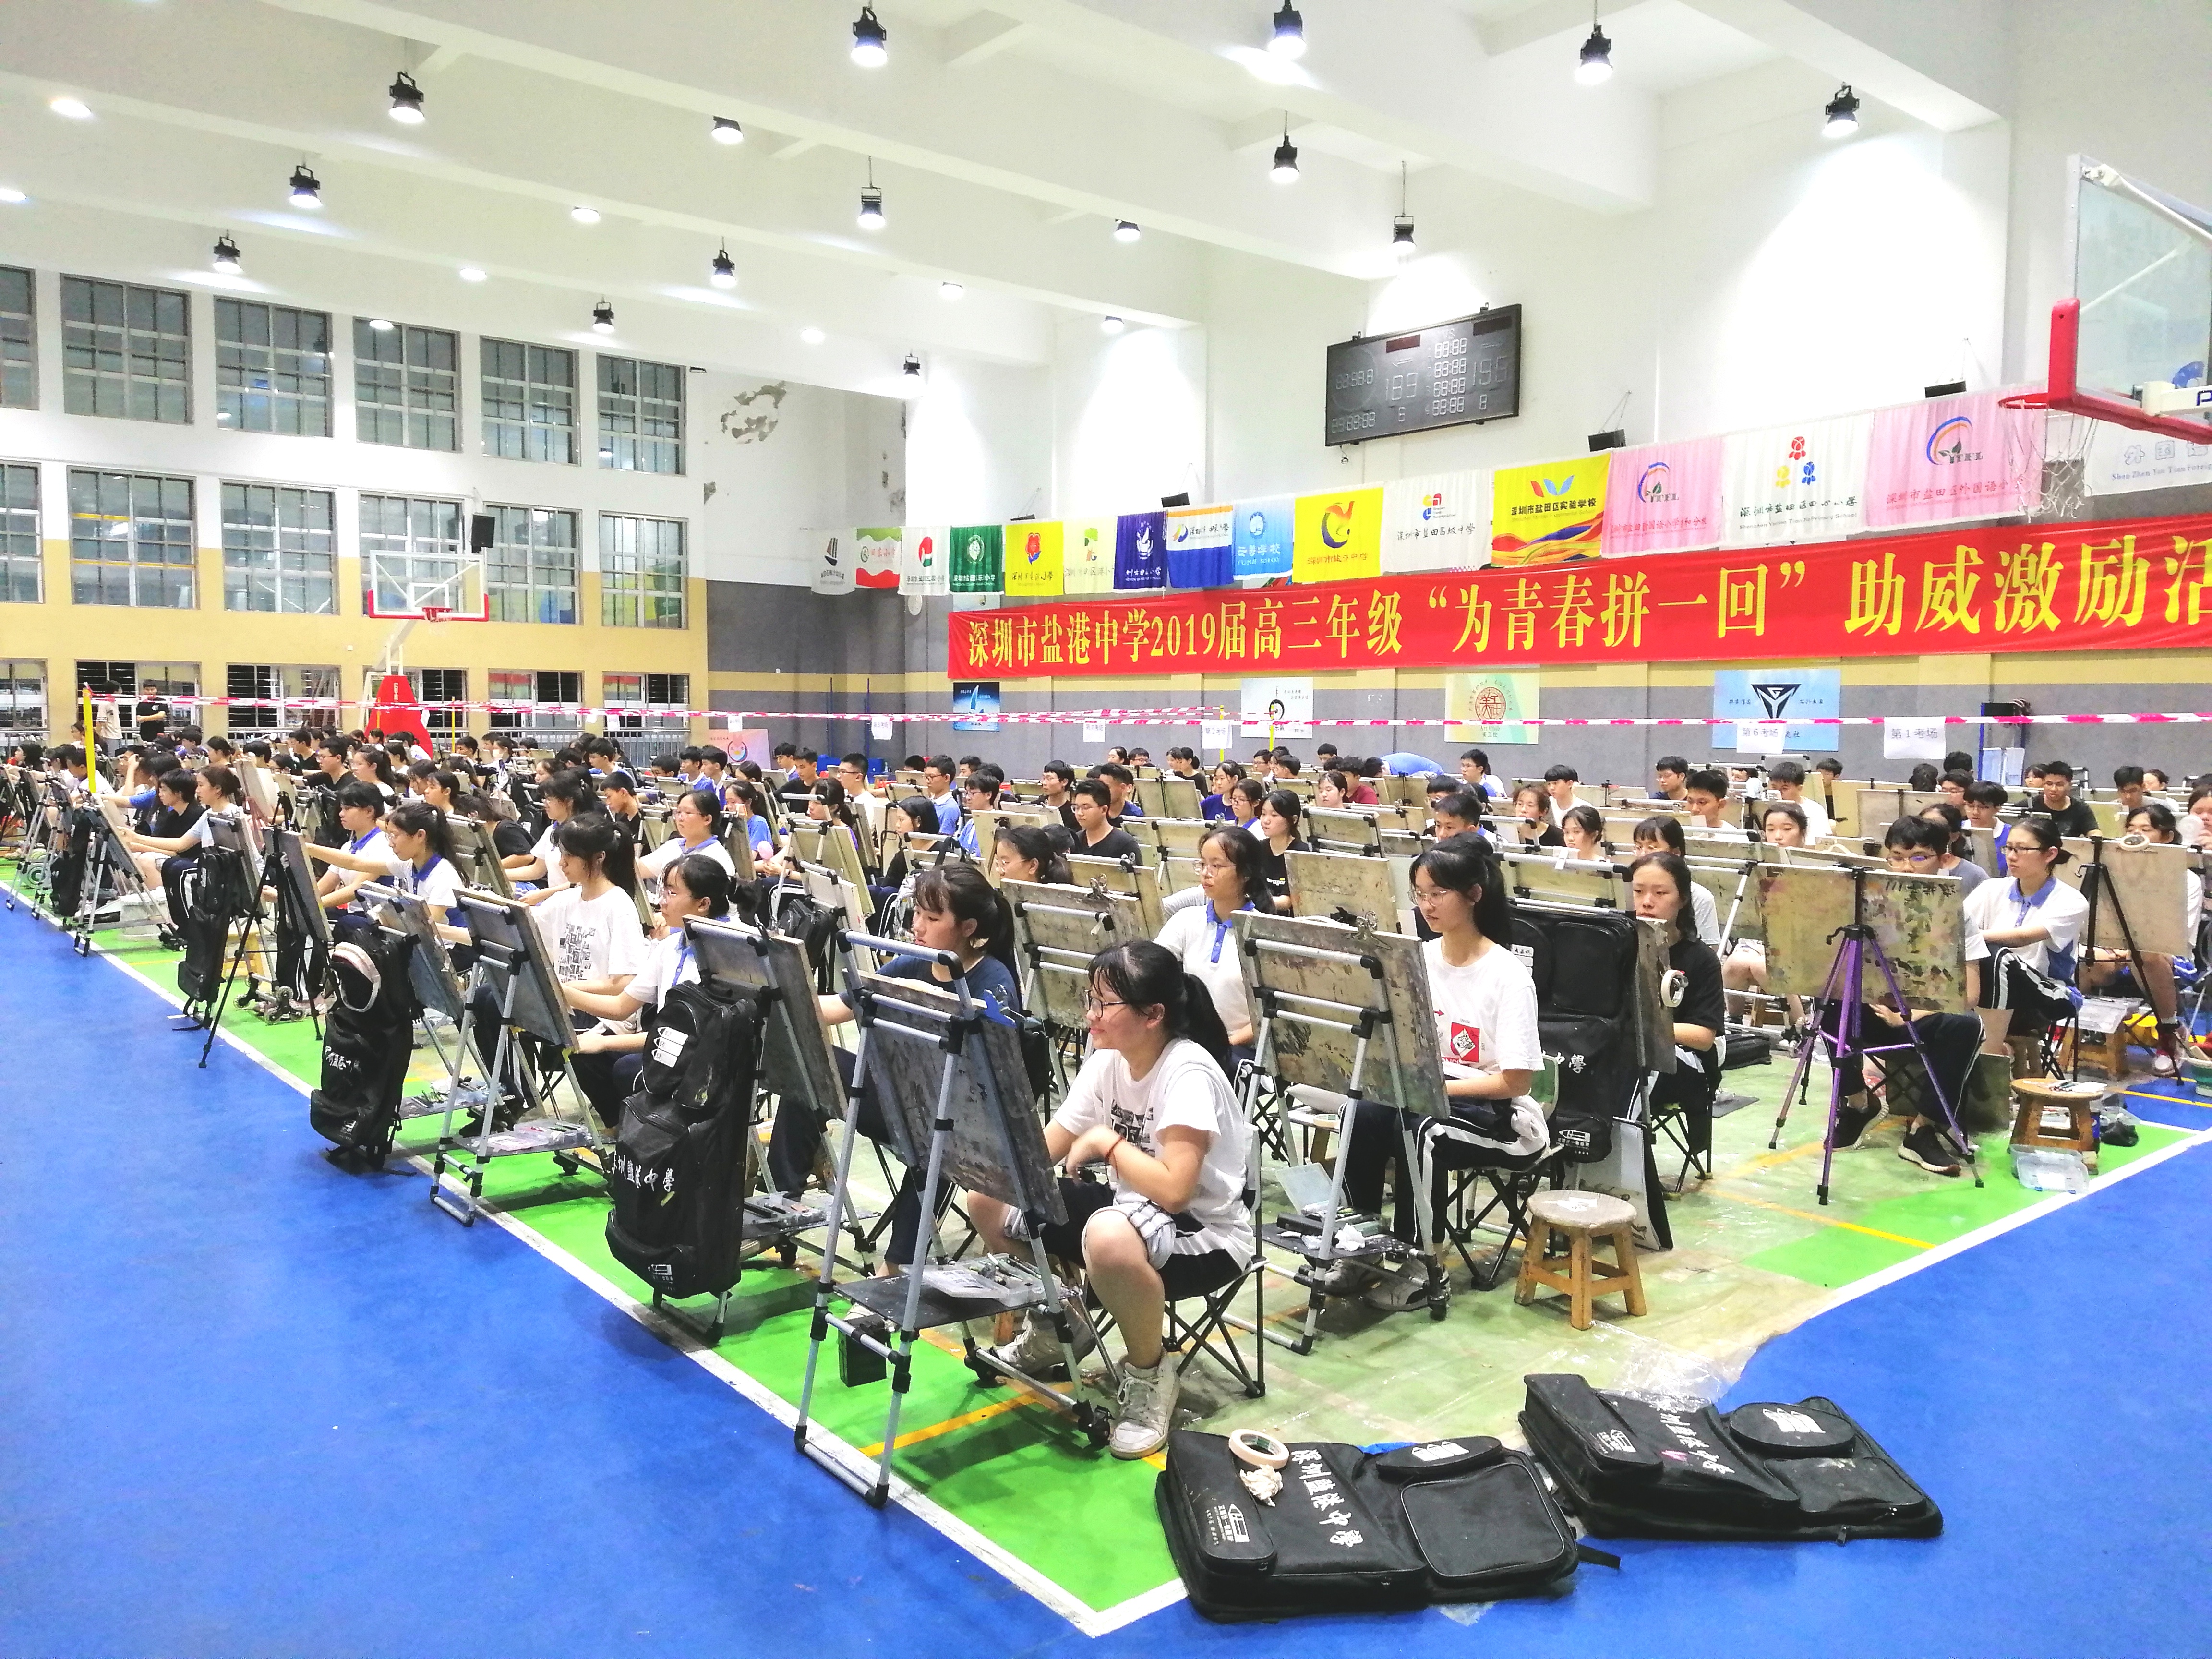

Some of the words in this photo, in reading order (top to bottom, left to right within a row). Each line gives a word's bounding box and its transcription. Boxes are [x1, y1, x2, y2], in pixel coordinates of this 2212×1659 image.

[1511, 498, 1597, 515] 深圳市盐田区实验学校
[1742, 728, 1778, 737] 第6考场
[1891, 727, 1938, 740] 第1考场
